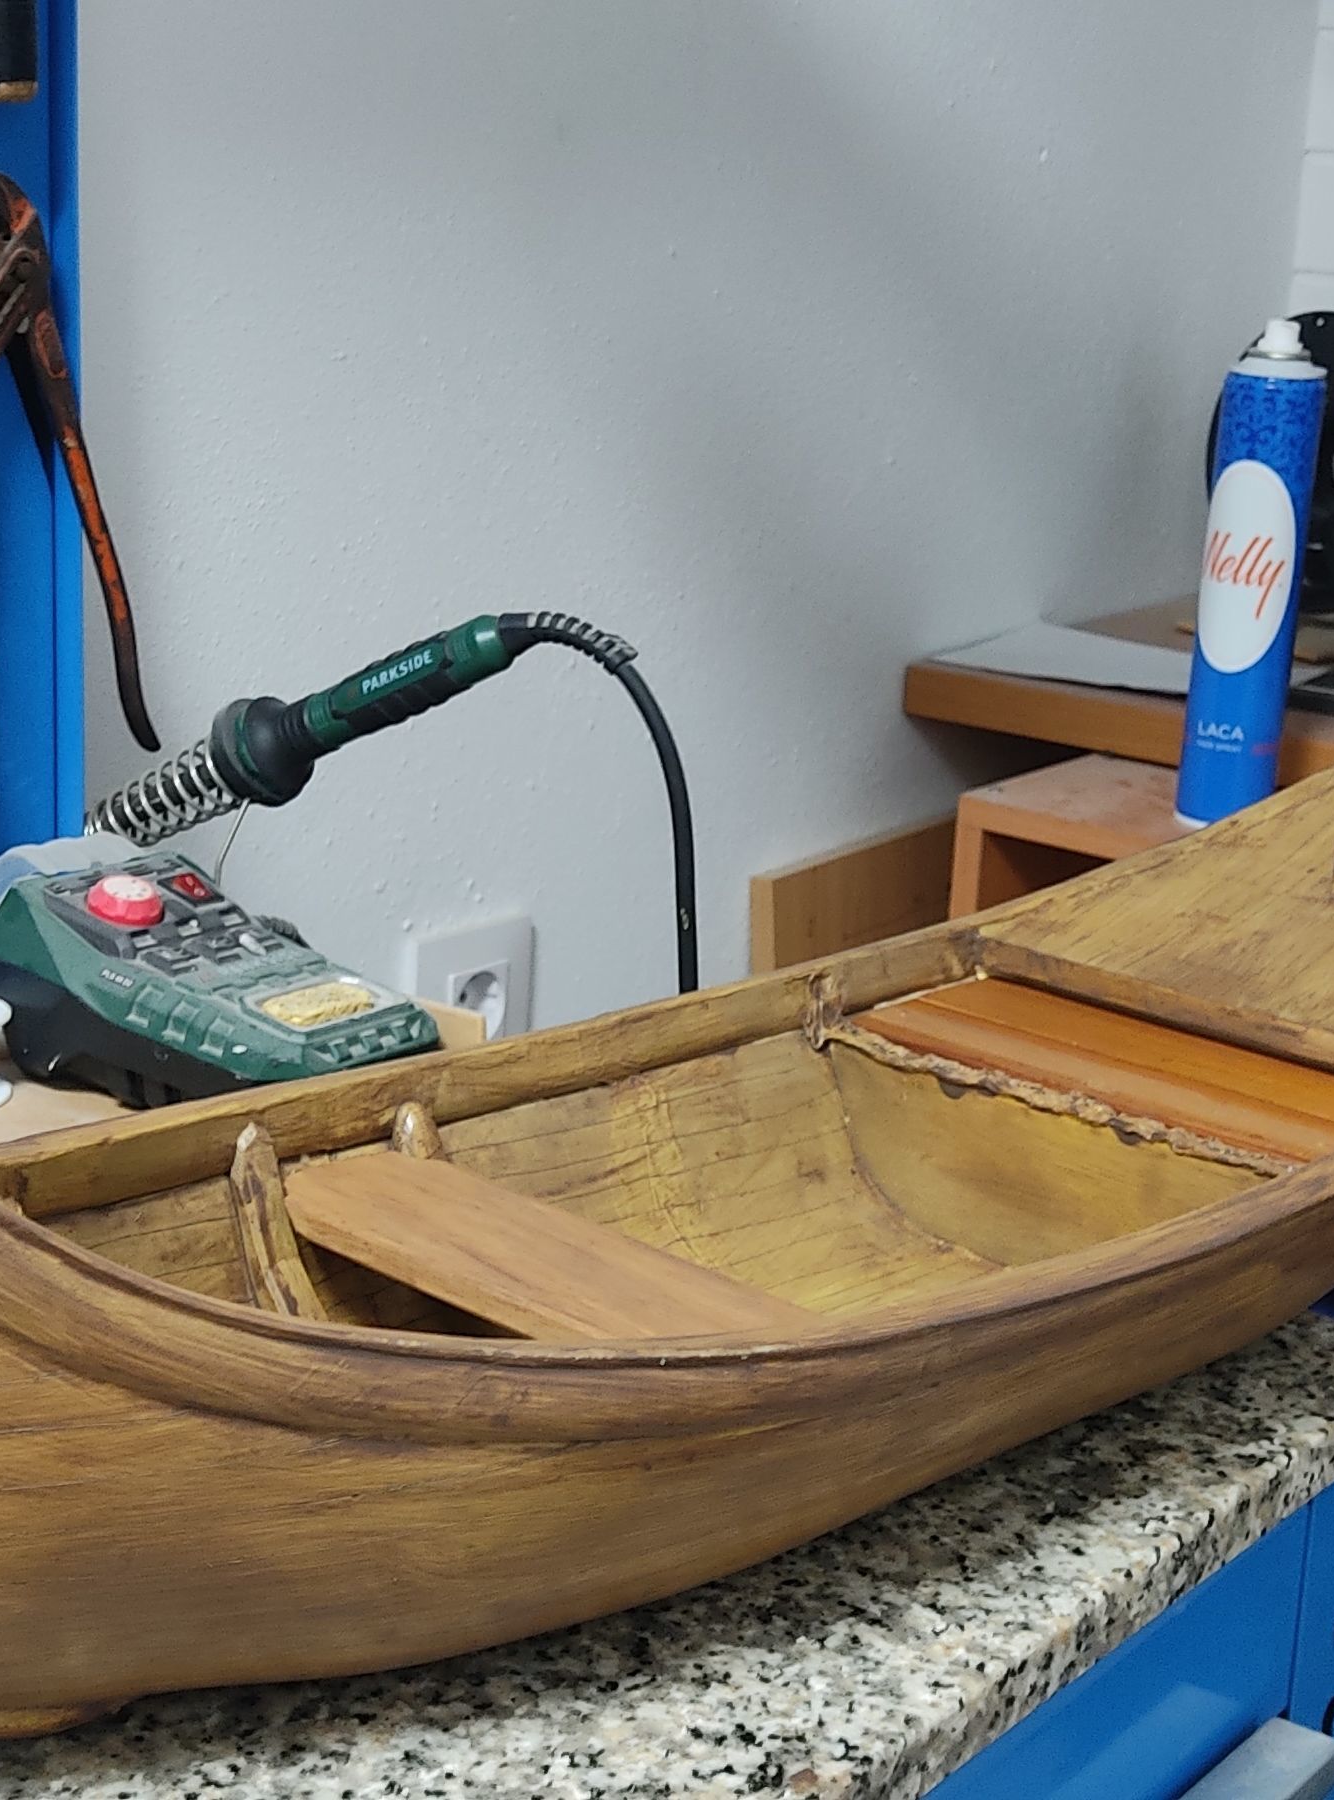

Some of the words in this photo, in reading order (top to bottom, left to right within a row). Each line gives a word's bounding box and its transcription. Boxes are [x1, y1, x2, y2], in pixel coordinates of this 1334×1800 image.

[1205, 529, 1285, 620] Nelly
[361, 648, 434, 696] PARKSIDE
[1197, 718, 1245, 742] LACA
